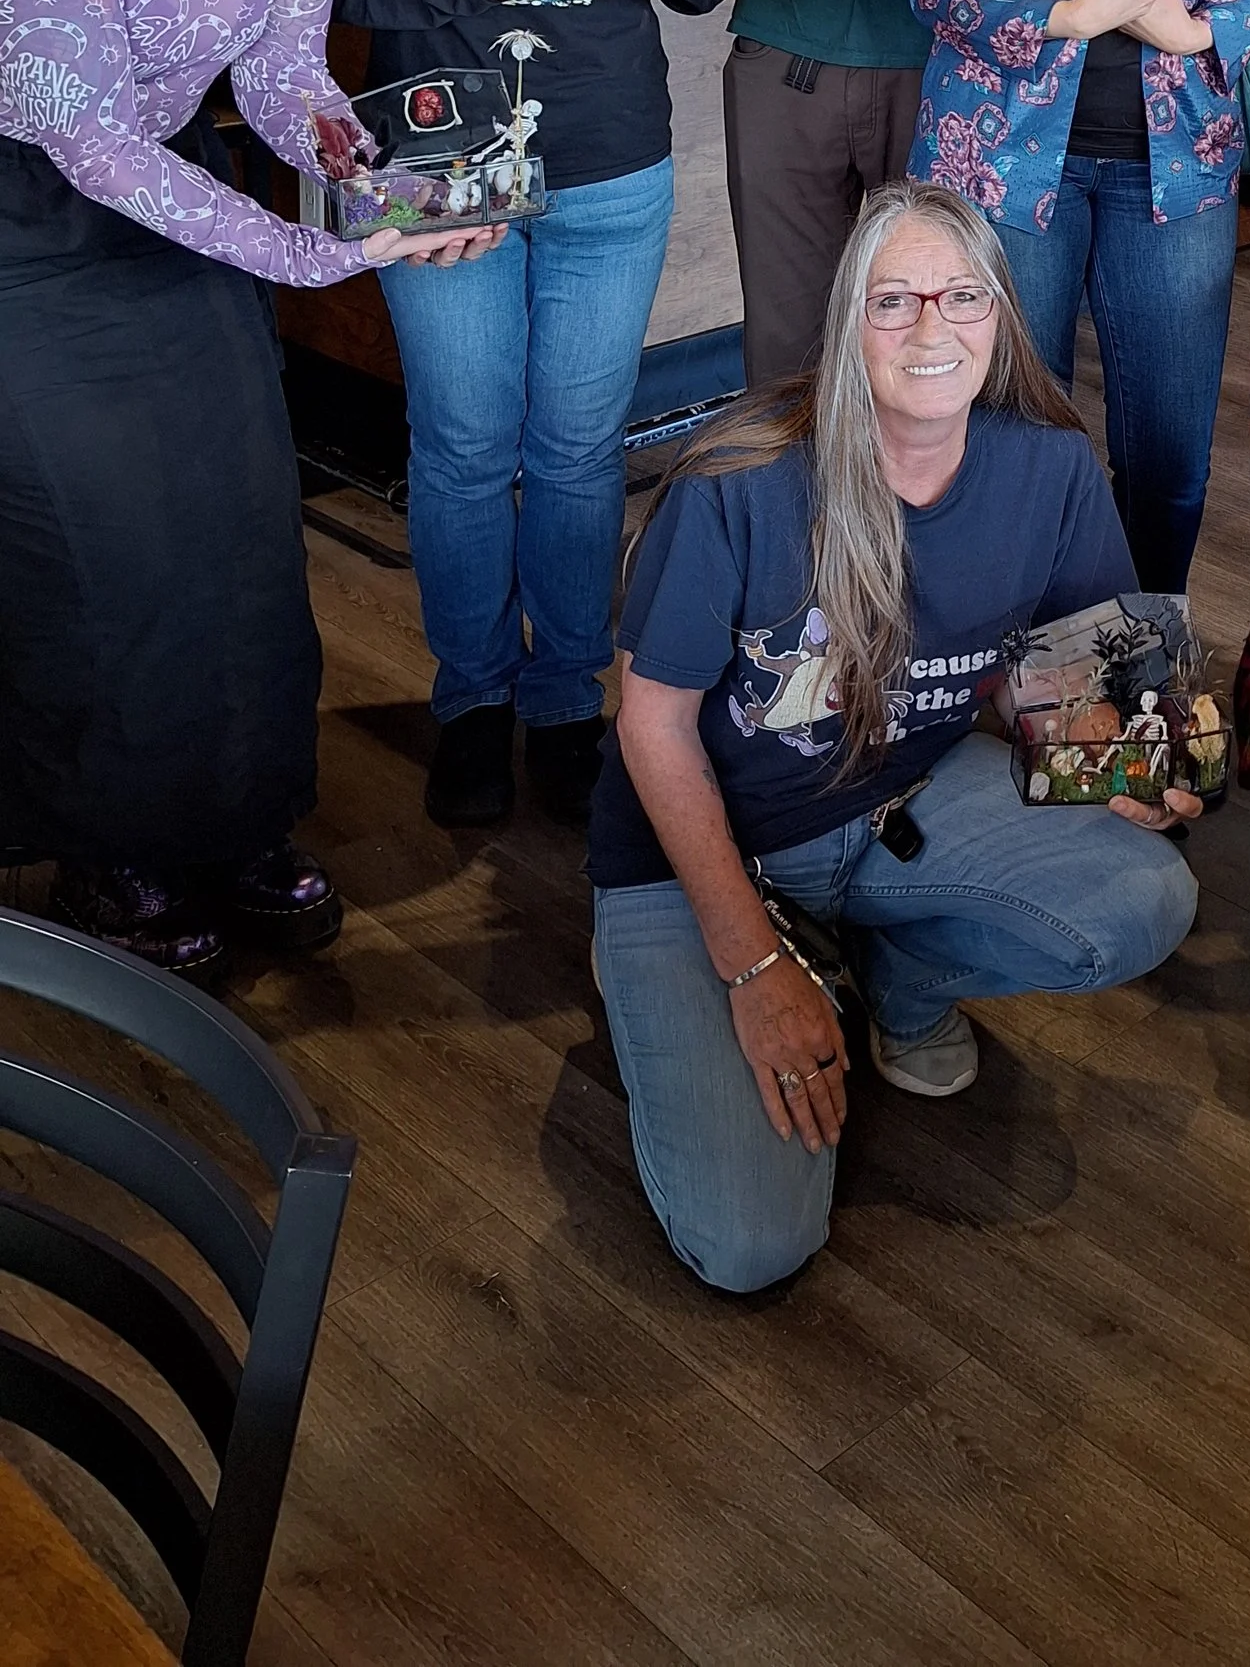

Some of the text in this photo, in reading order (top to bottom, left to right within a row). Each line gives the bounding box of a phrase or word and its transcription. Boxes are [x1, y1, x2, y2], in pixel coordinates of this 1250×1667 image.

[21, 81, 52, 99] AND
[904, 647, 998, 680] 'cause
[915, 686, 971, 712] the
